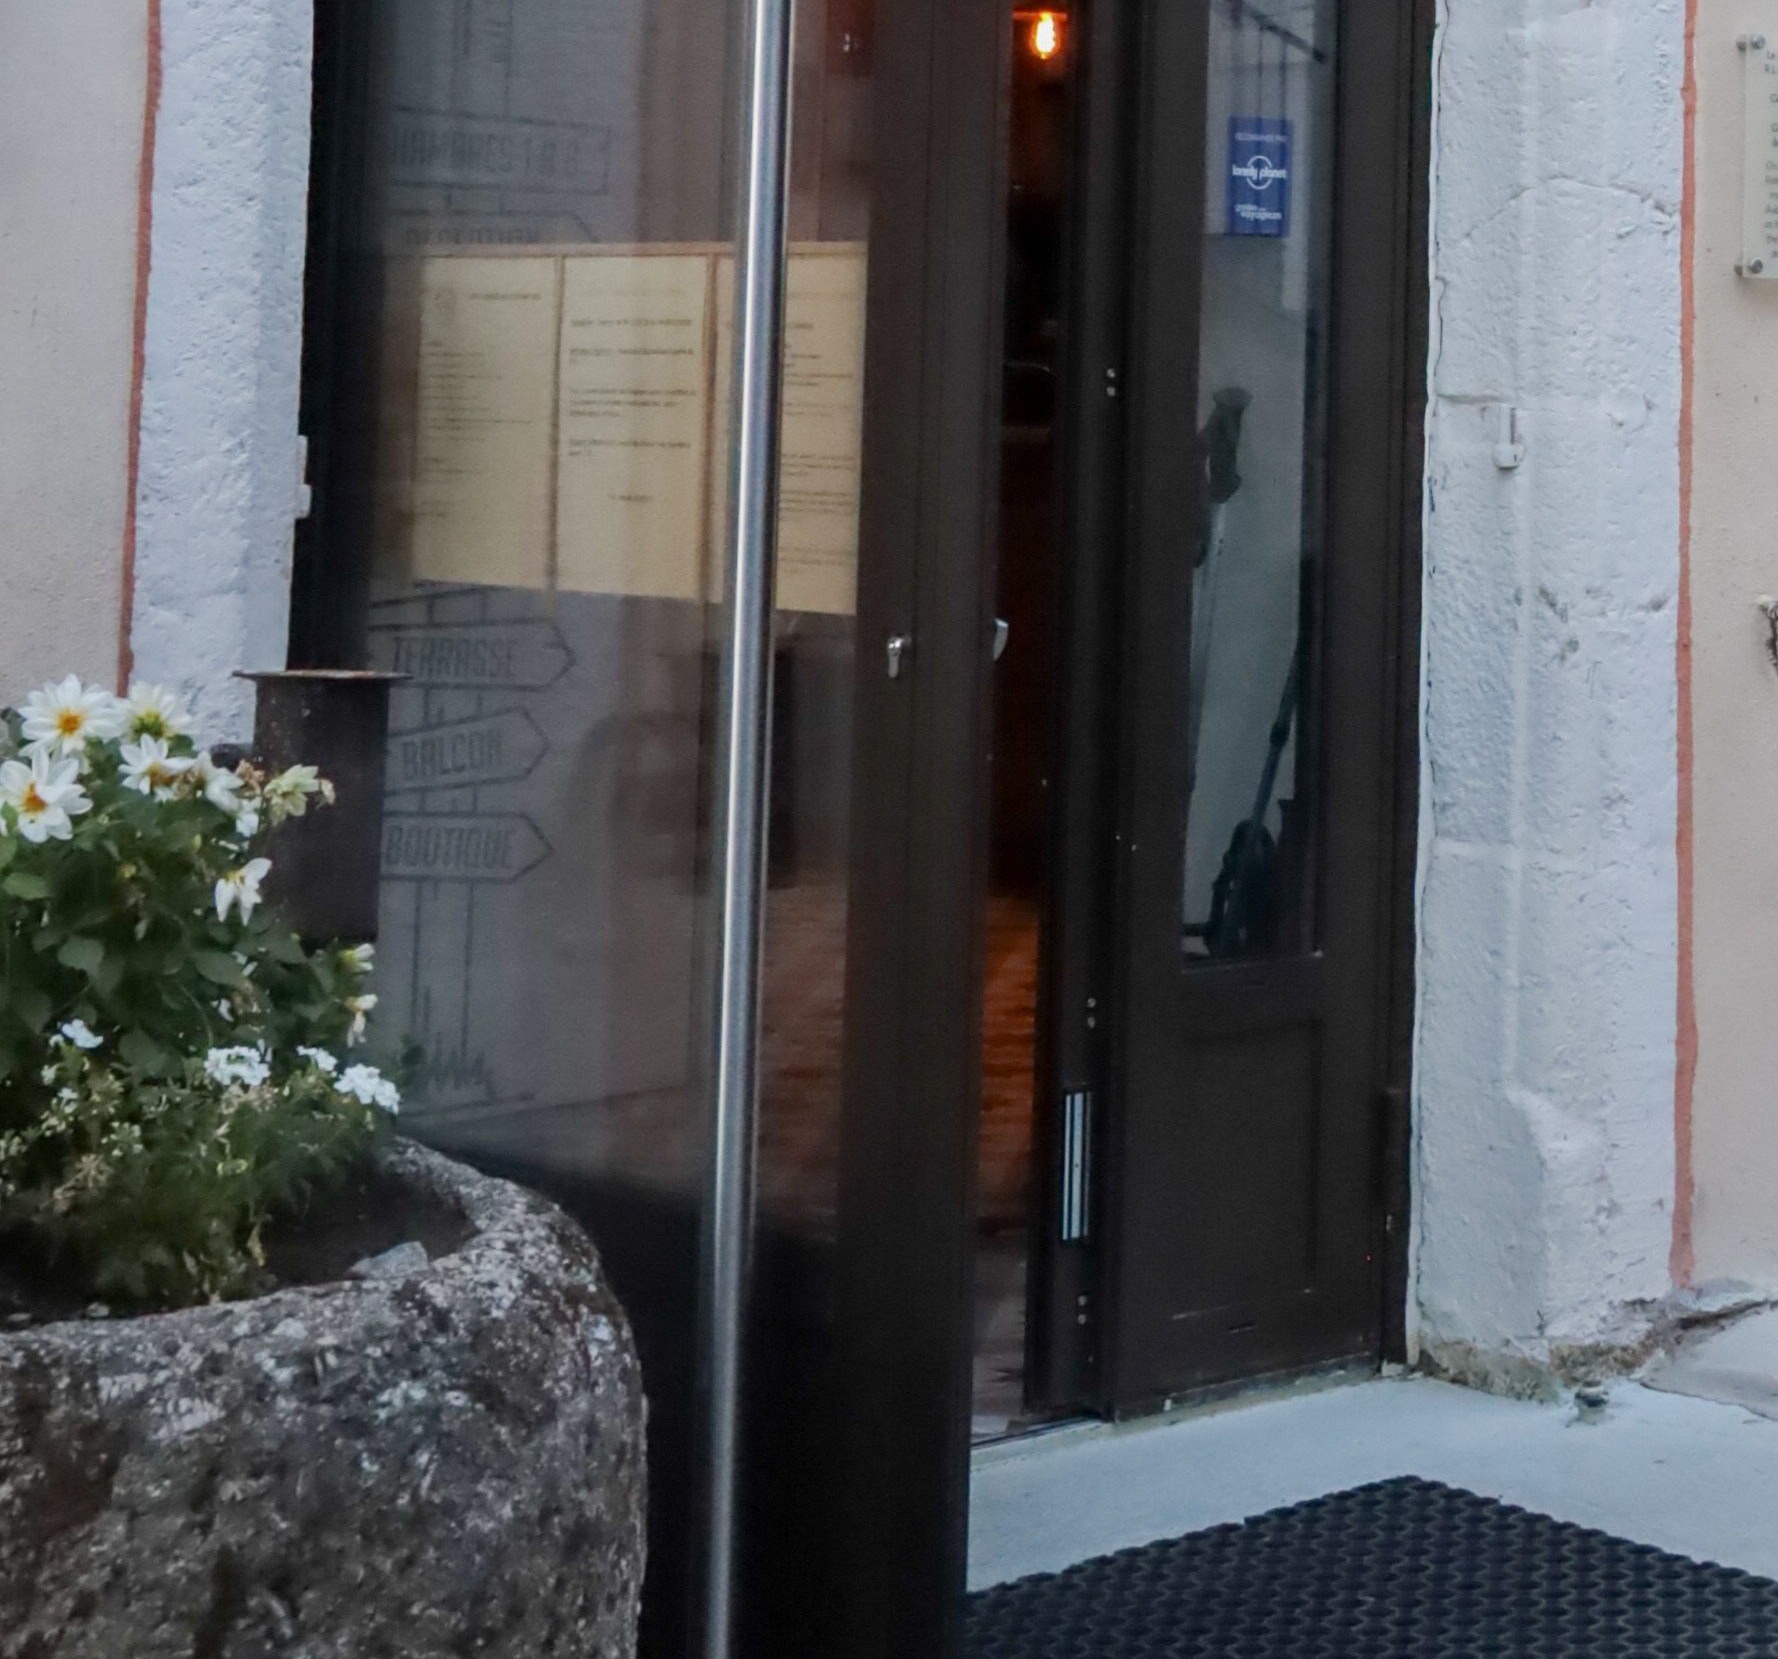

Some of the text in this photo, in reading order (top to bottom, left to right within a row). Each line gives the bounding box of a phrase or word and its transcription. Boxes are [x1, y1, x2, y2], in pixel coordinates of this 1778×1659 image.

[1232, 164, 1287, 180] lonely planet
[392, 637, 518, 678] TERRASSE
[401, 728, 502, 781] BALCON
[385, 825, 515, 870] BOUTIQUE
